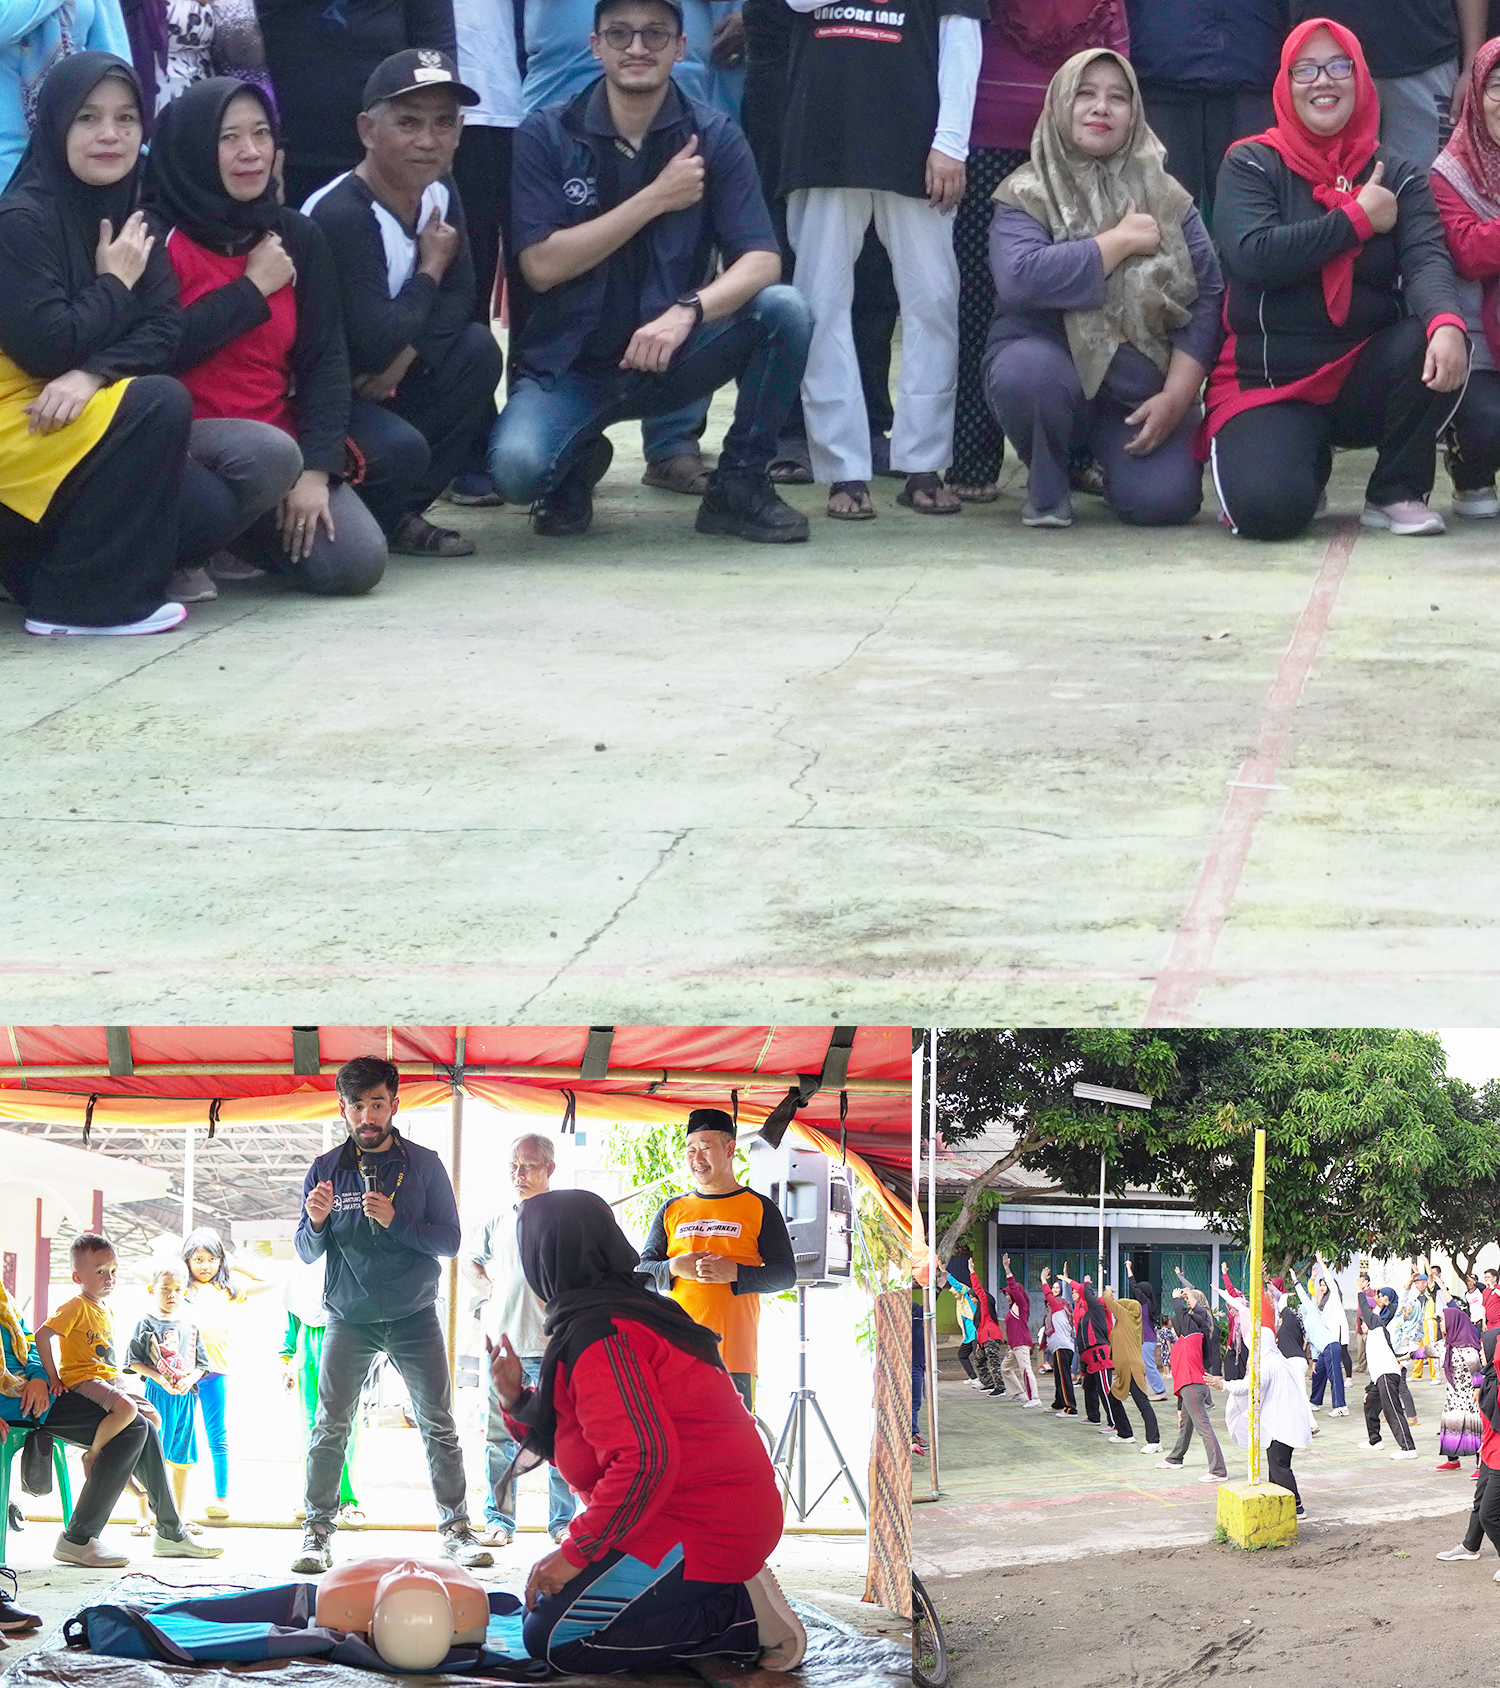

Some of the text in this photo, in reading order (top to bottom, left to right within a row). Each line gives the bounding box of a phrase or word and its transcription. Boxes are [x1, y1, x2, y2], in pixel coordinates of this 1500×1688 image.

[875, 10, 906, 26] LABS
[680, 1224, 737, 1233] SOCIAL WORKER
